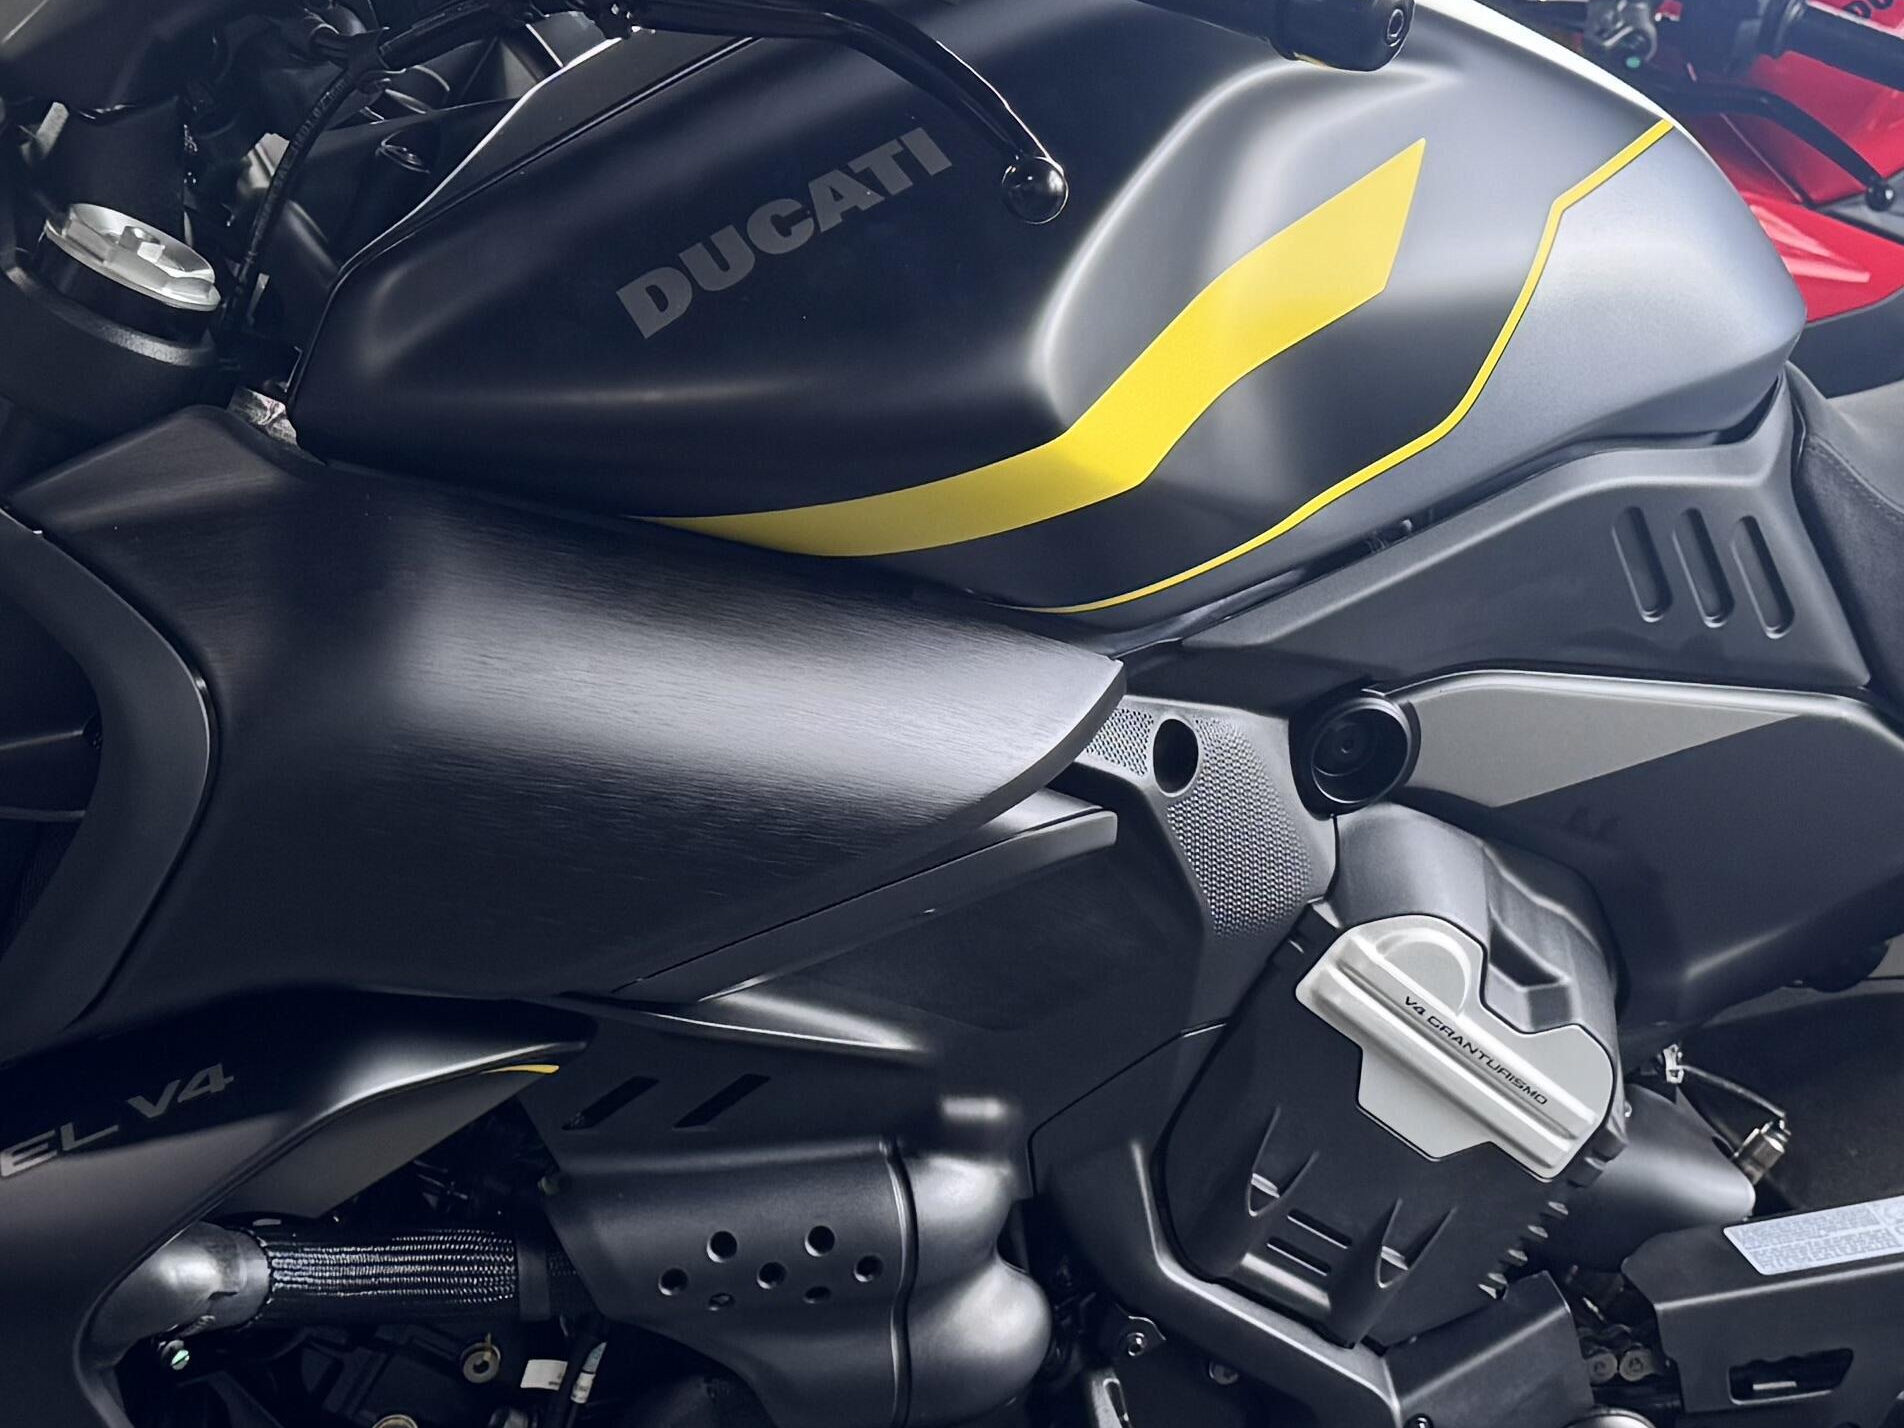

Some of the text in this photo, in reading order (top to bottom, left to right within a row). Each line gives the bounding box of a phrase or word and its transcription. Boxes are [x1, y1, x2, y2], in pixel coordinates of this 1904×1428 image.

[616, 127, 953, 340] DUCATI
[128, 1061, 235, 1121] V4
[1404, 994, 1548, 1106] V4 GRANTURISMO
